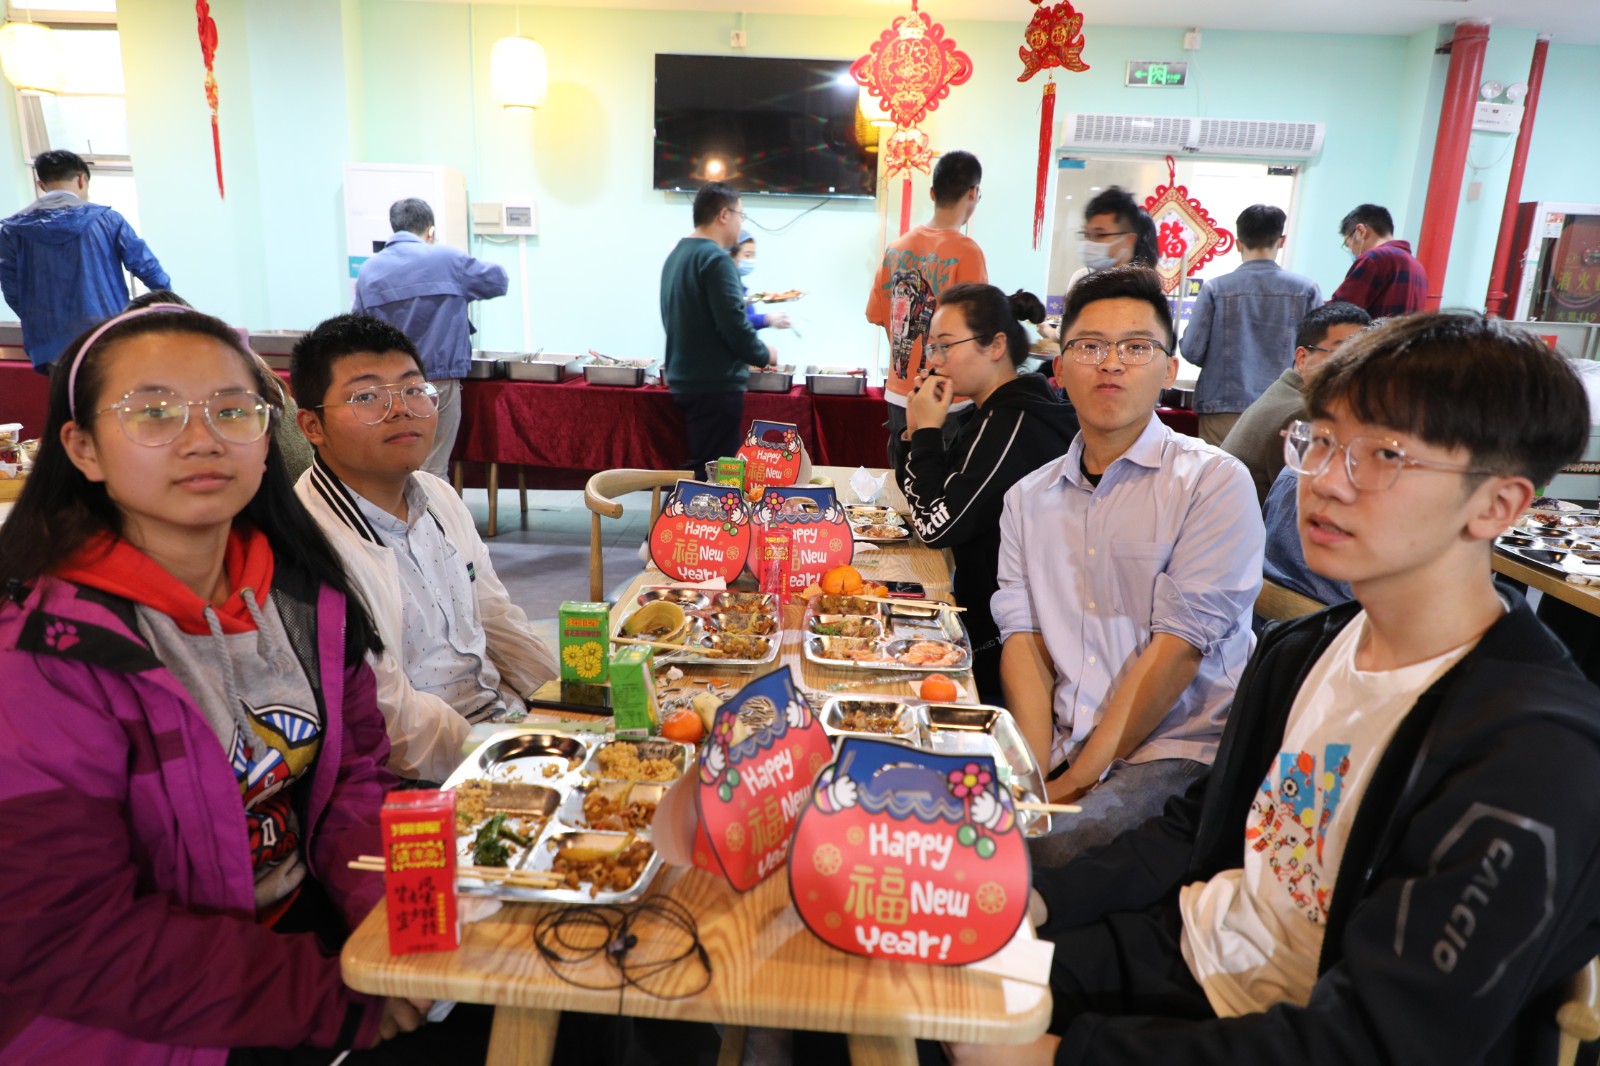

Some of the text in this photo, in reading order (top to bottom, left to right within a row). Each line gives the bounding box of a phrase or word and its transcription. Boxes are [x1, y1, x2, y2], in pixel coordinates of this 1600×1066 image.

[1157, 221, 1188, 258] 福
[1557, 271, 1600, 291] 消火
[756, 449, 781, 465] Happy
[748, 461, 766, 482] 福
[765, 467, 783, 480] New
[684, 521, 720, 541] Happy
[792, 527, 818, 544] appy
[672, 538, 724, 566] 福 New
[800, 548, 827, 565] New
[789, 572, 821, 588] ear!
[741, 748, 794, 797] Happy
[748, 794, 785, 855] 福
[869, 822, 954, 871] Happy
[844, 864, 970, 926] 福 New
[1432, 837, 1514, 973] CALCIO
[855, 925, 952, 961] Year!
